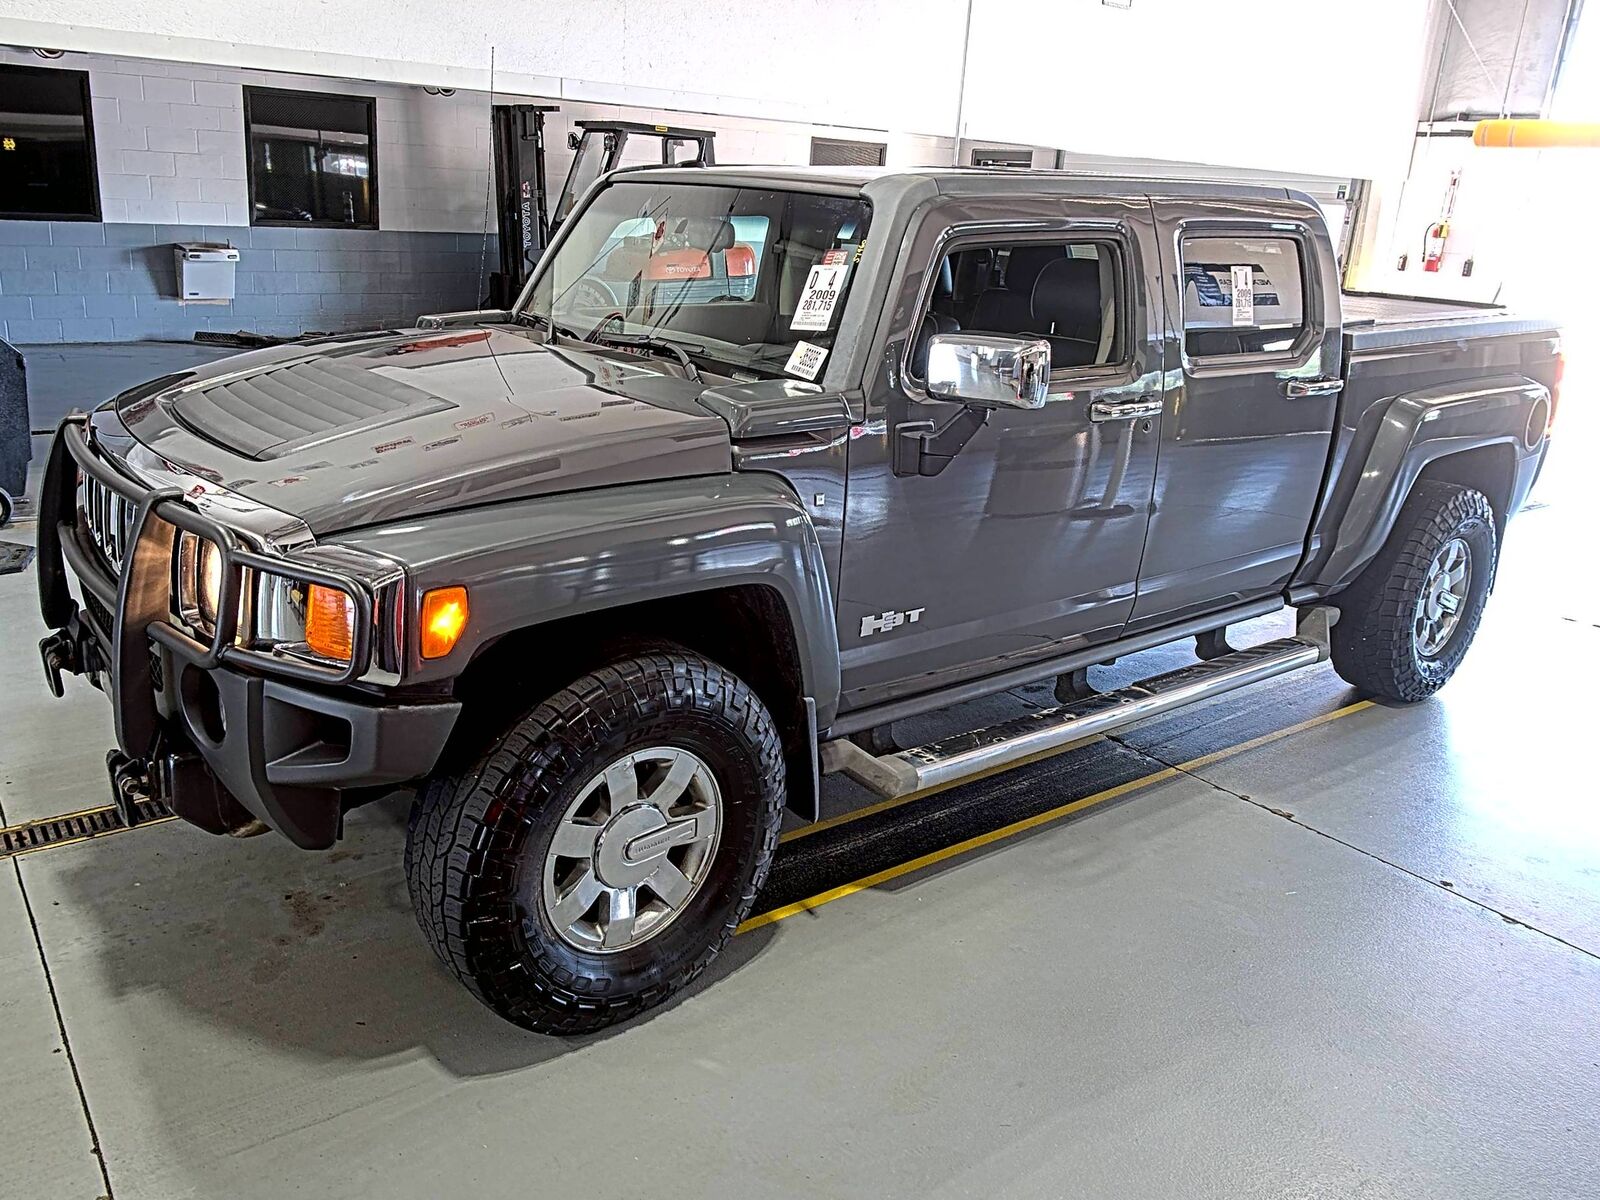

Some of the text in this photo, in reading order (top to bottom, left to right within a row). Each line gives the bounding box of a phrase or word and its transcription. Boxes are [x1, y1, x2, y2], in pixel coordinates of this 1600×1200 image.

[521, 201, 532, 249] TOYOTA
[828, 270, 838, 290] 4
[808, 289, 836, 300] 2009
[1236, 288, 1252, 298] 2009
[802, 299, 833, 312] 281,715
